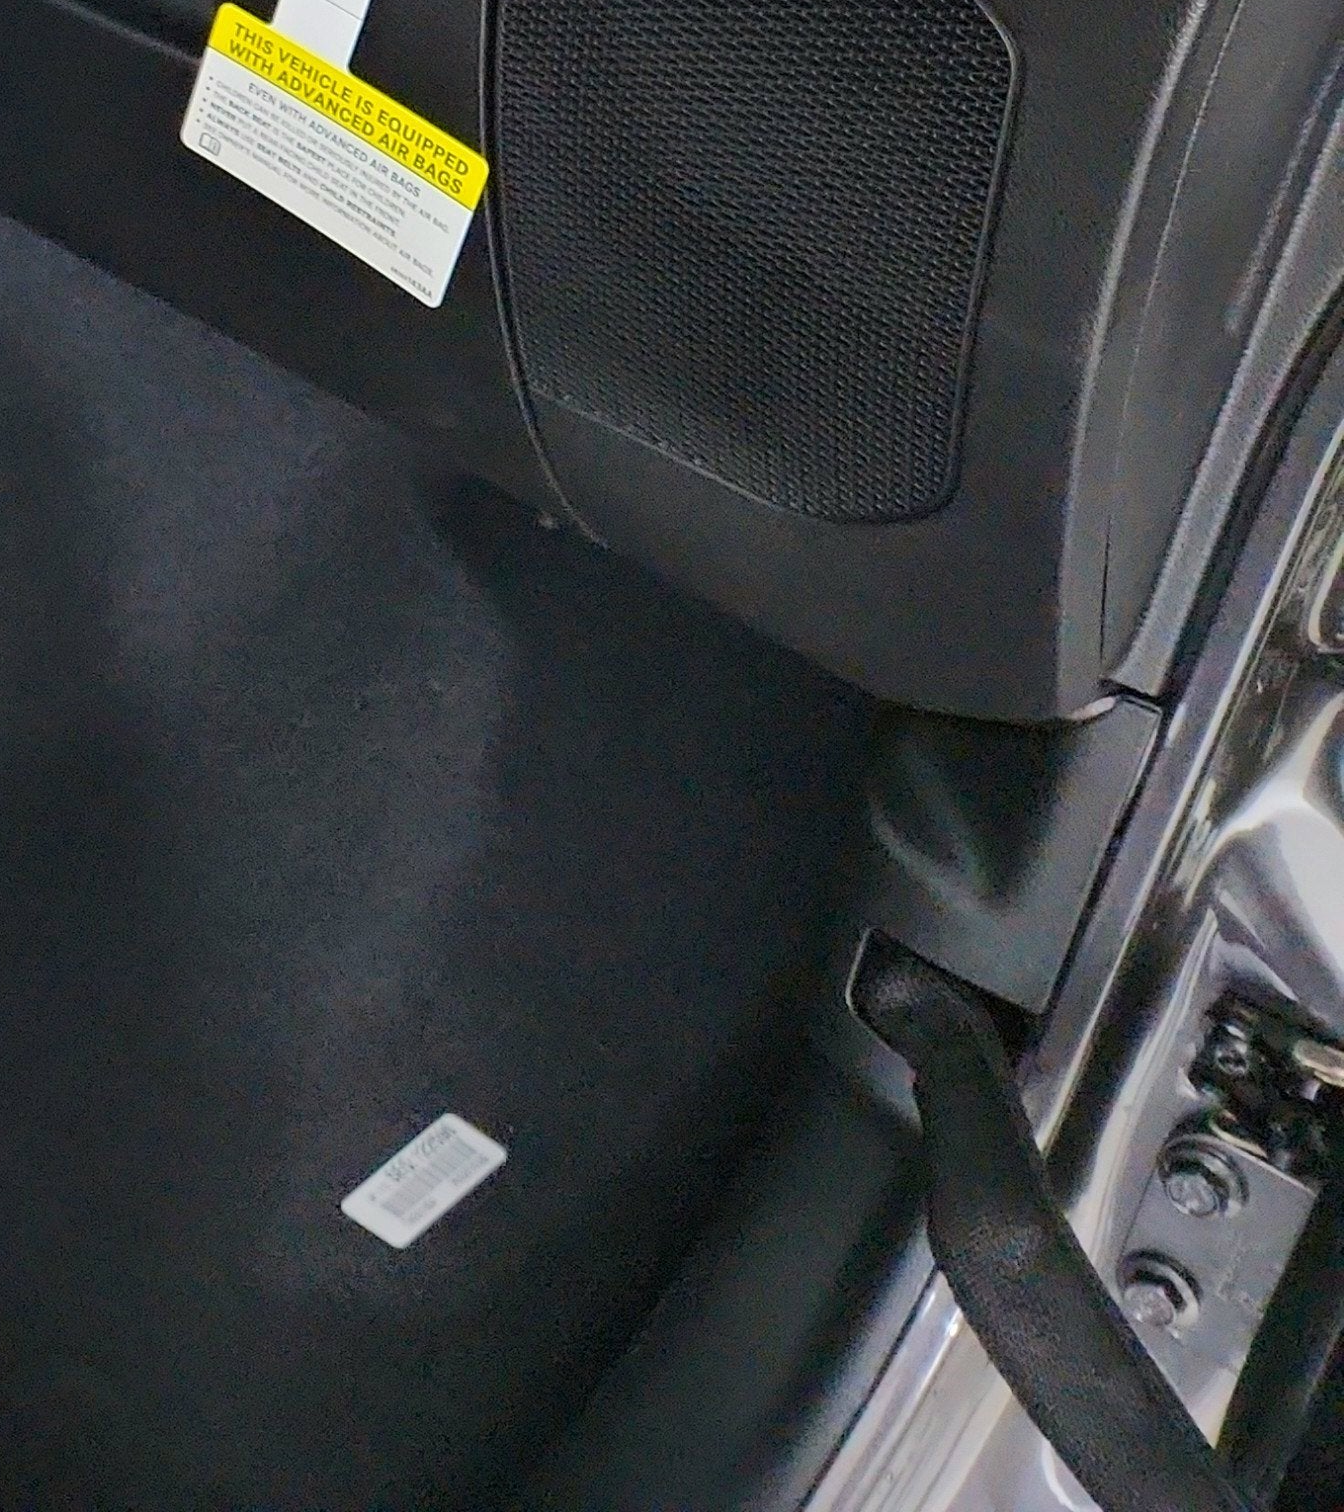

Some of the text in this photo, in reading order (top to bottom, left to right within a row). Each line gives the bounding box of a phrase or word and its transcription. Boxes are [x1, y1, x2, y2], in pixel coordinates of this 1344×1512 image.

[229, 40, 461, 193] WITH ADVANCED AIR BAGS
[234, 22, 468, 176] THIS VEHICLE IS EQUIPPED
[248, 82, 420, 197] EVEN WITH ADVANCED AIR BAGS
